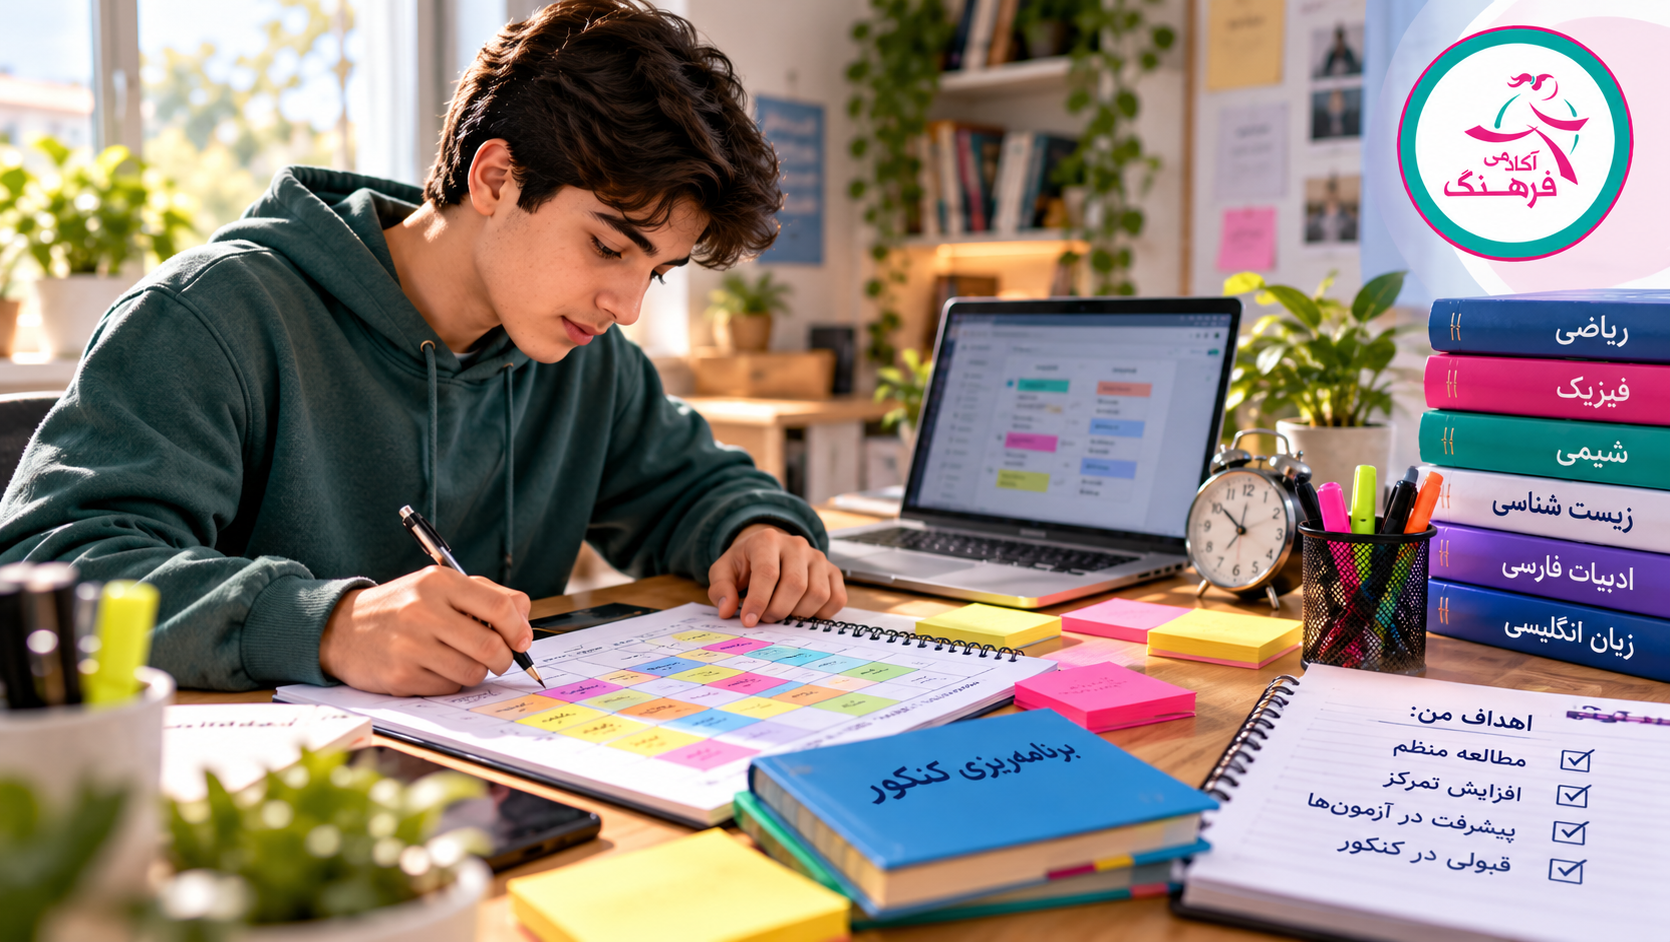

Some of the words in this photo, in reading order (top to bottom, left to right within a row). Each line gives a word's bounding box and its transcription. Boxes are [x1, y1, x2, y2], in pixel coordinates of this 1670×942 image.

[1555, 315, 1629, 348] ریاضی
[1556, 376, 1630, 408] فیزیک
[1556, 440, 1628, 468] شیمی
[1226, 488, 1235, 500] 11
[1243, 484, 1255, 497] 12
[1263, 491, 1268, 503] 1
[1211, 502, 1223, 514] 10
[1492, 491, 1562, 516] شناسی
[1272, 508, 1281, 520] 2
[1568, 503, 1634, 533] زیست
[1204, 521, 1211, 532] 9
[1275, 528, 1284, 541] 3
[1206, 541, 1213, 552] 8
[1265, 548, 1274, 561] 4
[1217, 556, 1224, 568] 7
[1232, 564, 1240, 576] 6
[1252, 561, 1259, 574] 5
[1502, 554, 1562, 583] فارسی
[1568, 561, 1634, 594] ادبیات
[1504, 616, 1583, 643] انگلیسی
[1410, 706, 1453, 724] من:
[1461, 708, 1533, 732] اهداف
[1393, 739, 1448, 757] منظم
[1456, 748, 1527, 768] مطالعه
[869, 760, 951, 805] کنکور
[1382, 771, 1440, 792] تمرکز
[1447, 781, 1522, 804] افزایش
[1397, 812, 1423, 826] در
[1431, 814, 1516, 844] پیشرفت
[1336, 837, 1406, 855] کنکور
[1409, 849, 1437, 864] در
[1446, 852, 1511, 875] قبولی
